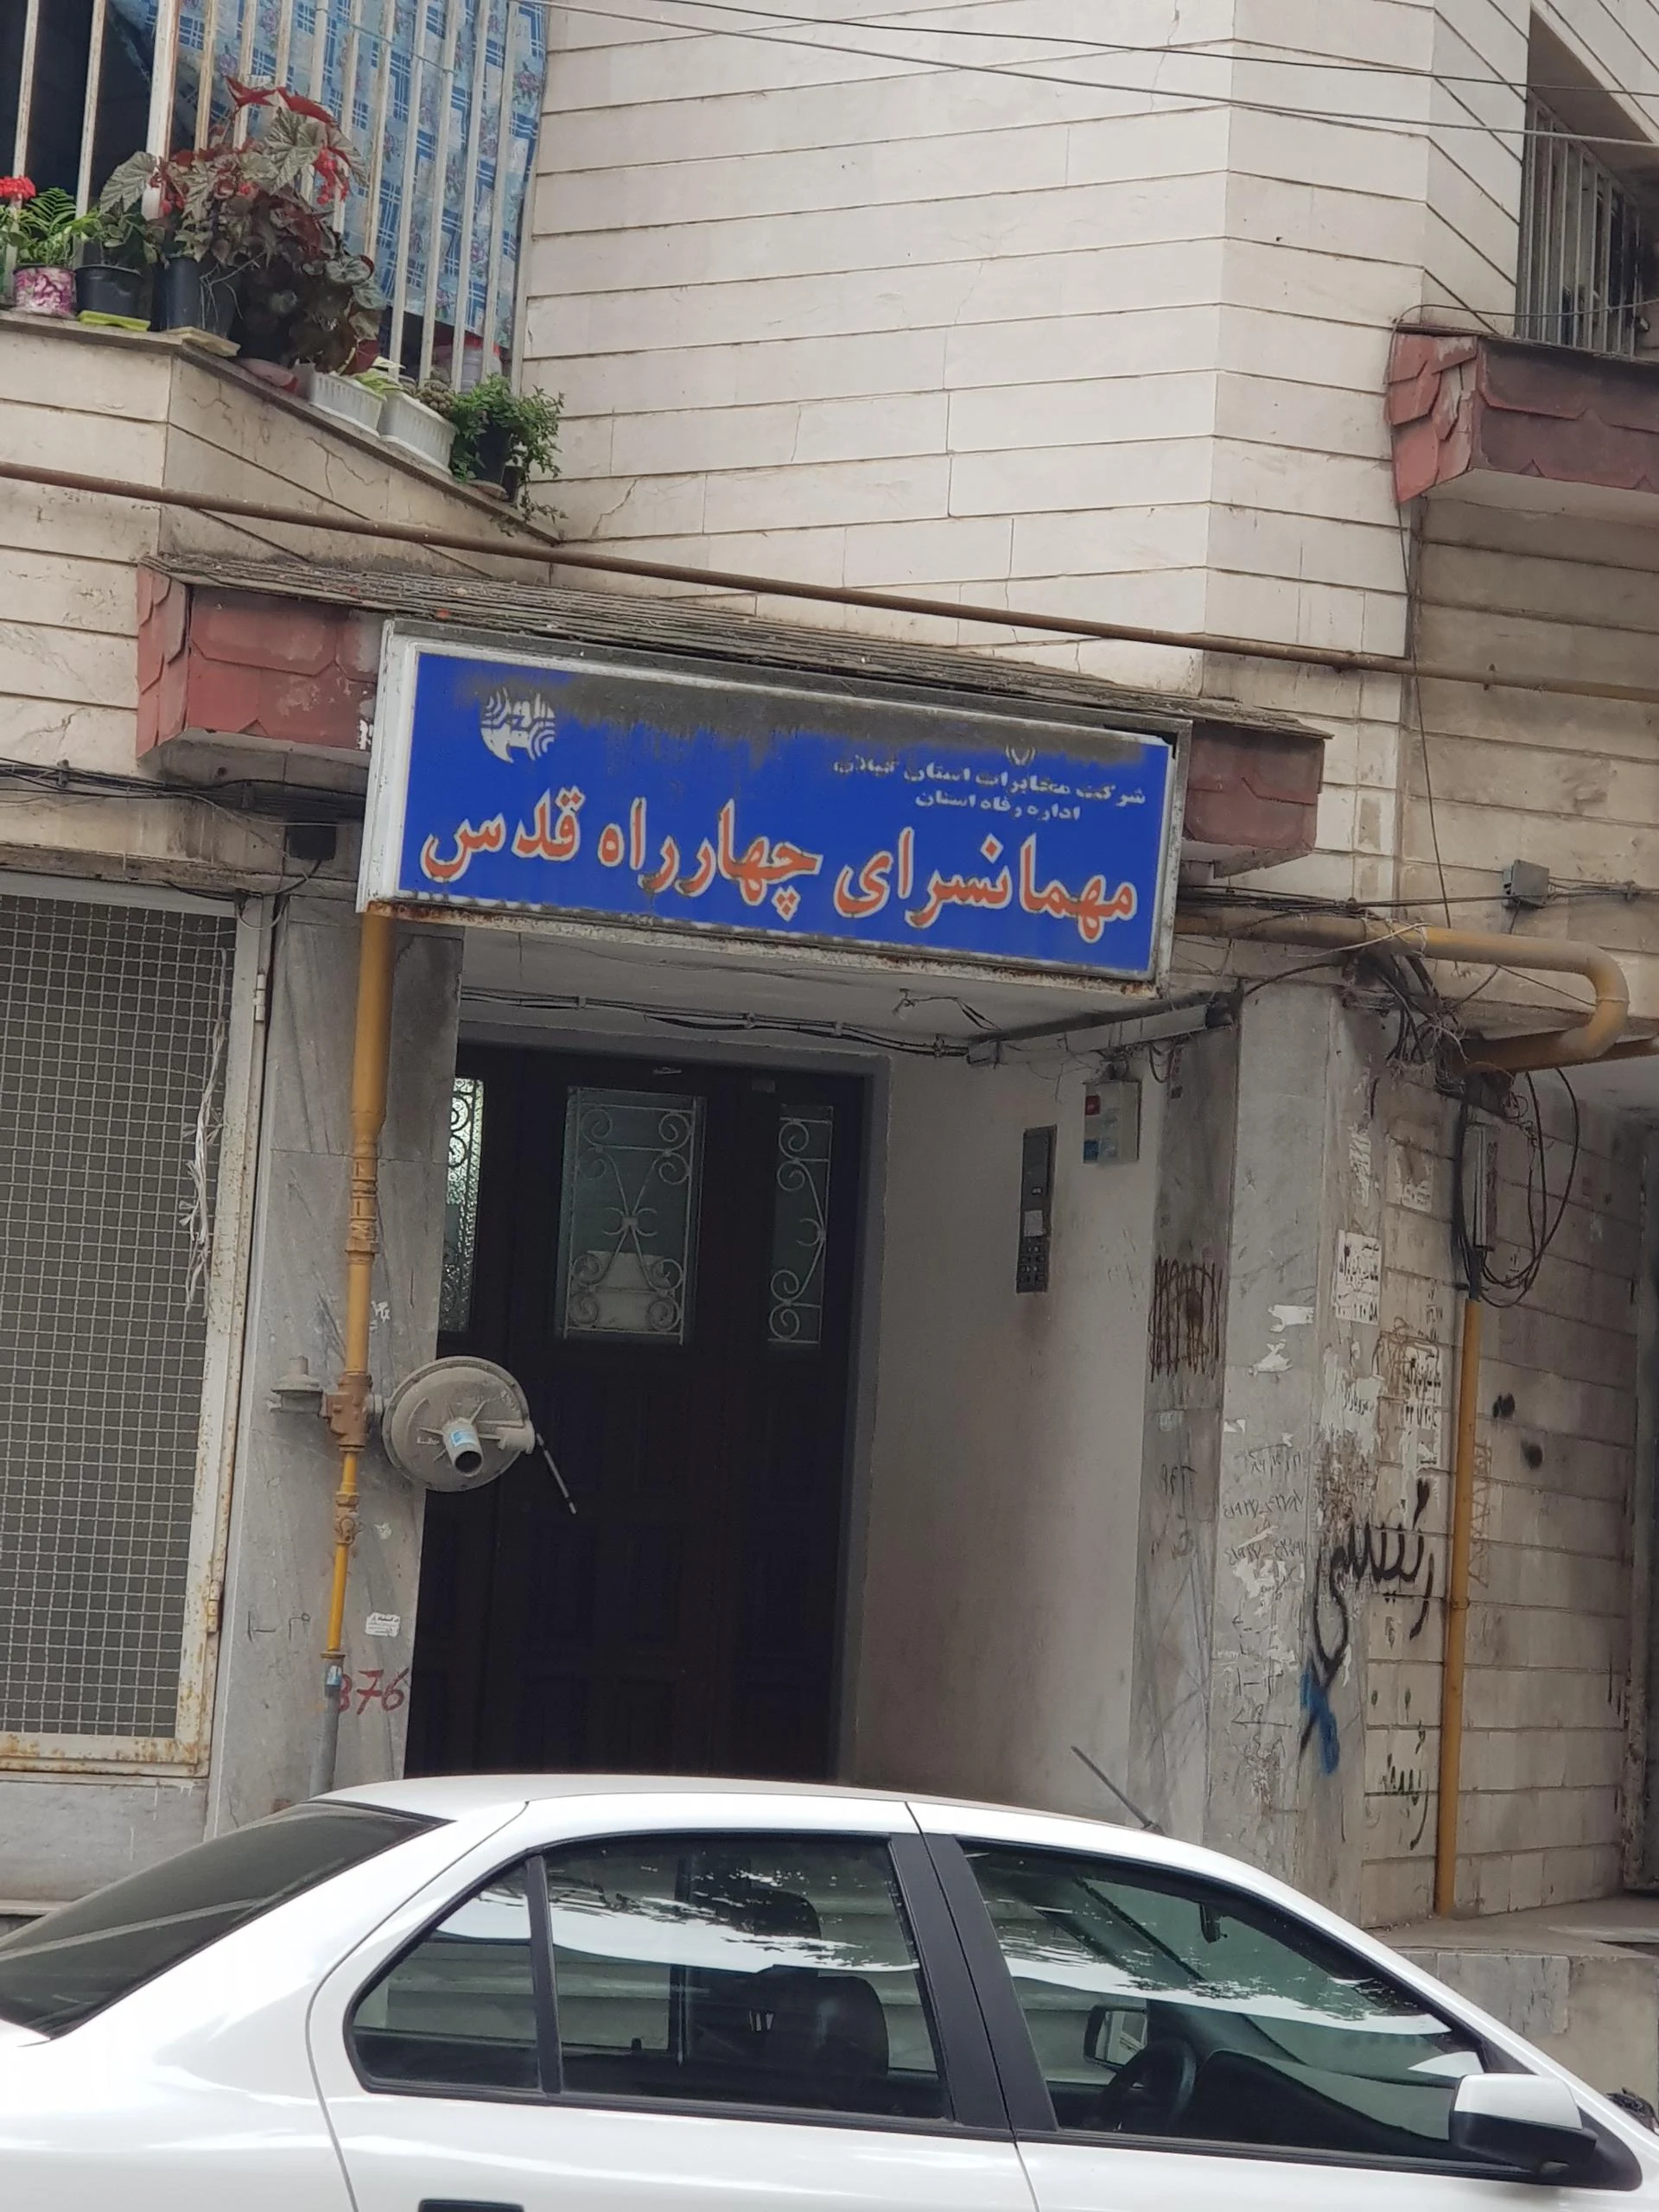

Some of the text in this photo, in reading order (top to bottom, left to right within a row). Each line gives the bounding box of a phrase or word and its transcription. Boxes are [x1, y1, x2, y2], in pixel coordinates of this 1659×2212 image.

[904, 761, 971, 783] استان
[975, 768, 1071, 796] مخابرات
[915, 788, 976, 810] استان
[1076, 782, 1147, 807] شرکت
[1026, 804, 1082, 823] اداره
[420, 785, 586, 883] قدس
[834, 826, 1138, 944] مهمانسرای
